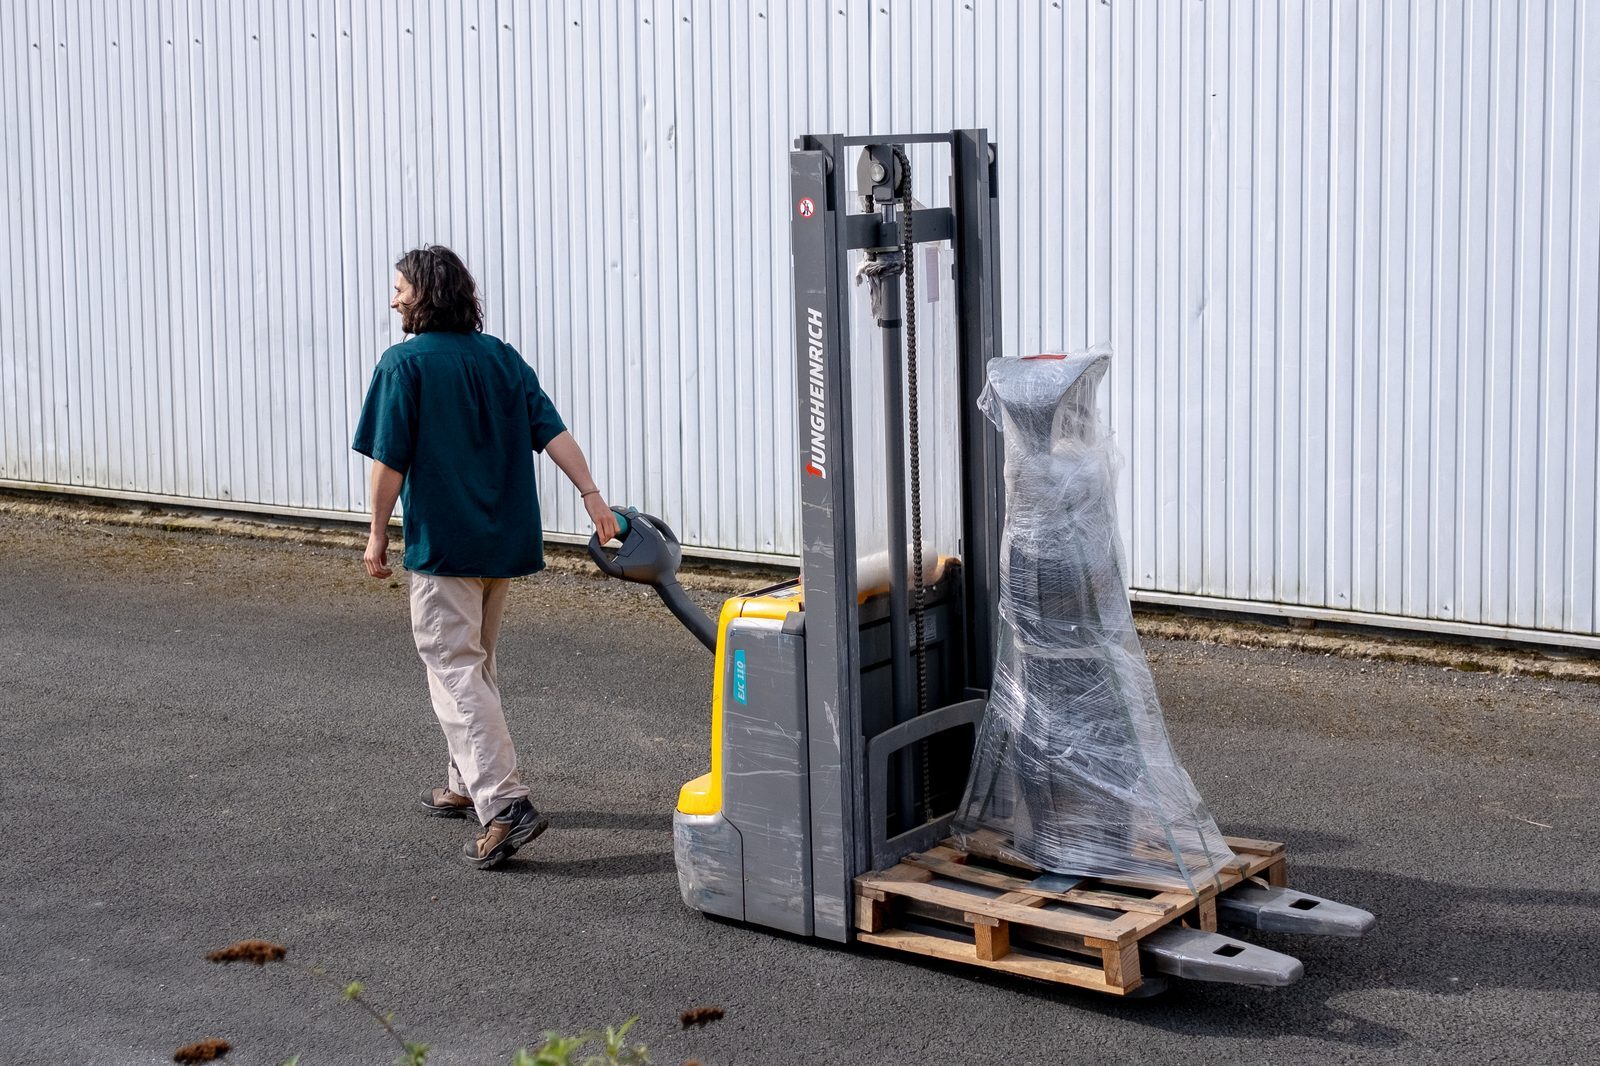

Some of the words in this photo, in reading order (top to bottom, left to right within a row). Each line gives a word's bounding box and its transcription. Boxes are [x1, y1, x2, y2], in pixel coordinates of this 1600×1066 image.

[807, 307, 827, 479] JUNGHEINRICH
[736, 660, 745, 680] 110
[737, 681, 745, 700] EJC
